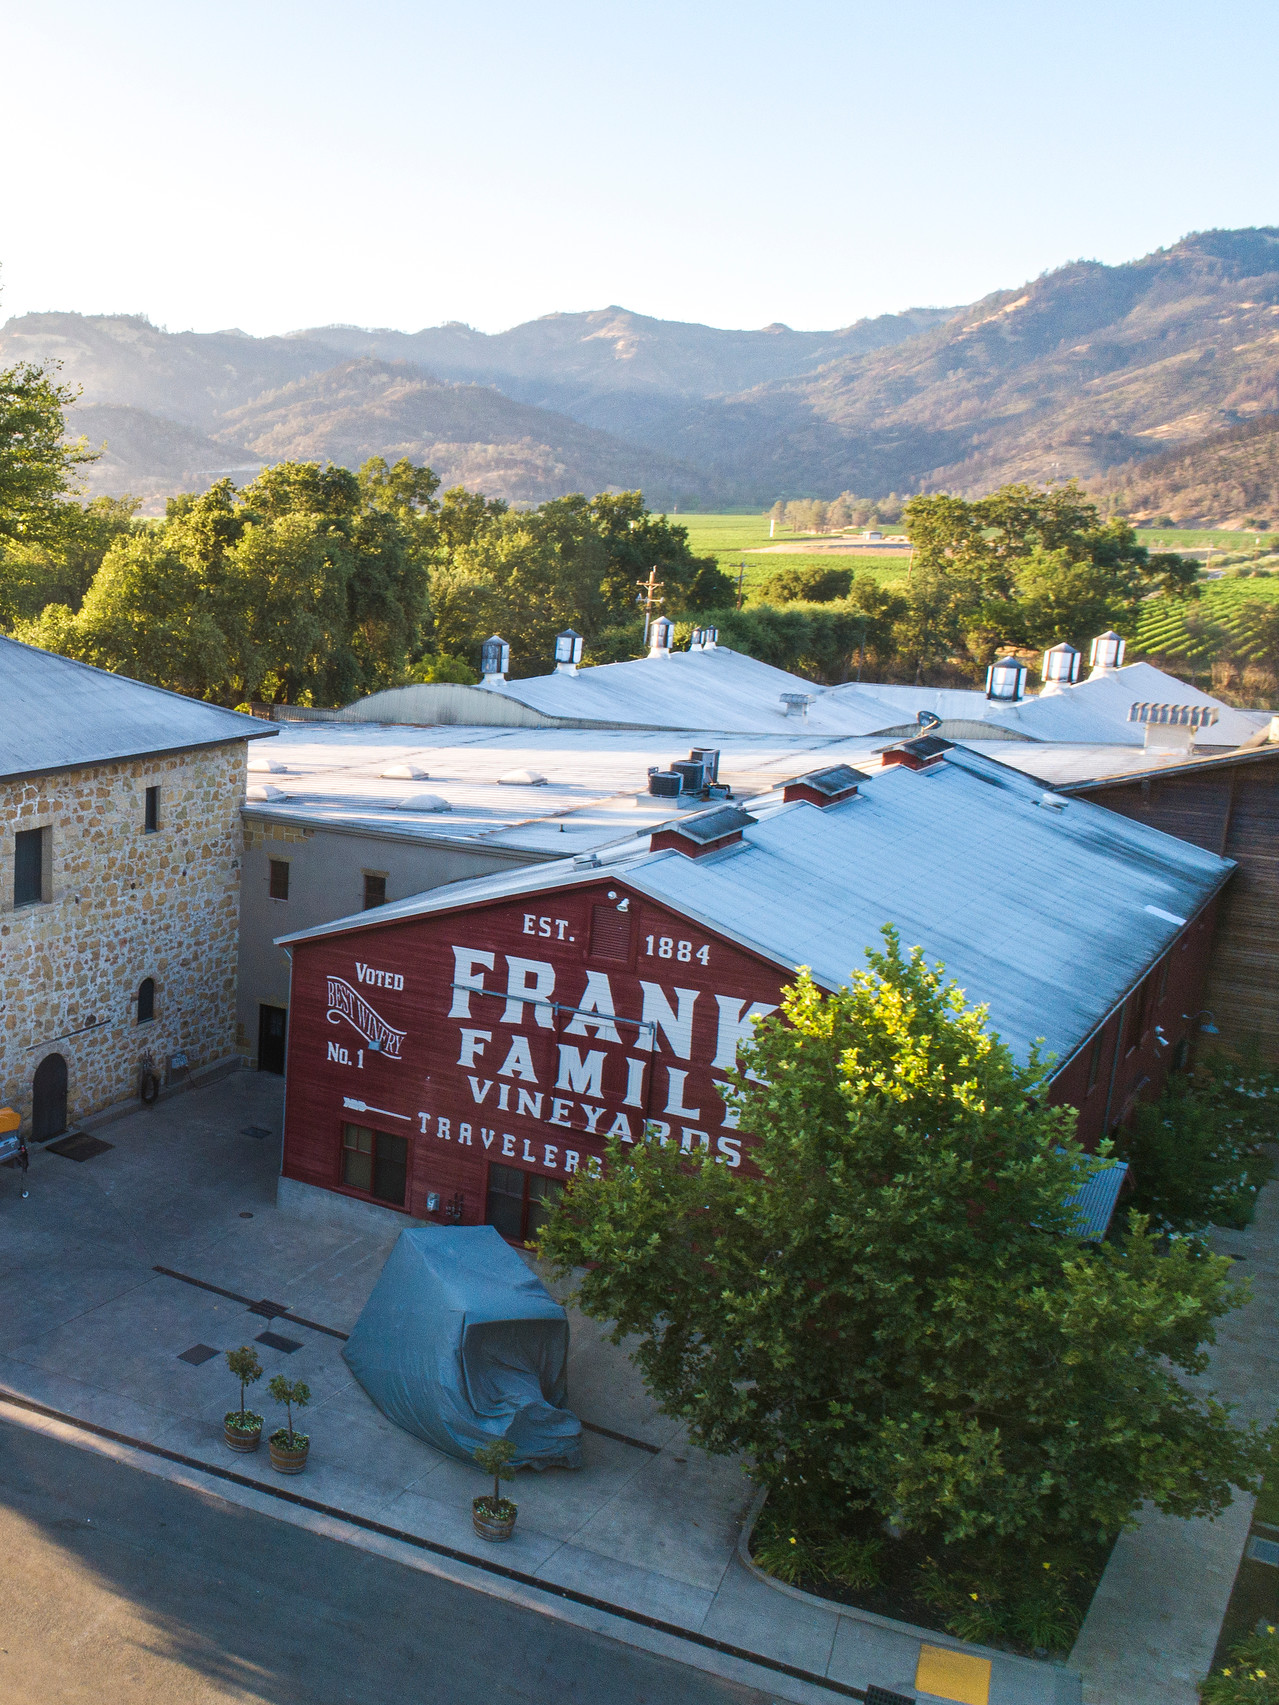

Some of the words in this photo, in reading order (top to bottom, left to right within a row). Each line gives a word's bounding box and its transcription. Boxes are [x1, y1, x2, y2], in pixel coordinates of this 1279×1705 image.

[523, 913, 575, 942] EST.
[645, 934, 711, 966] 1884
[327, 980, 355, 1019] BEST
[357, 999, 405, 1055] WINERY
[447, 945, 779, 1087] FRANK
[357, 1048, 364, 1069] 1
[466, 1075, 742, 1168] VINEYARDS
